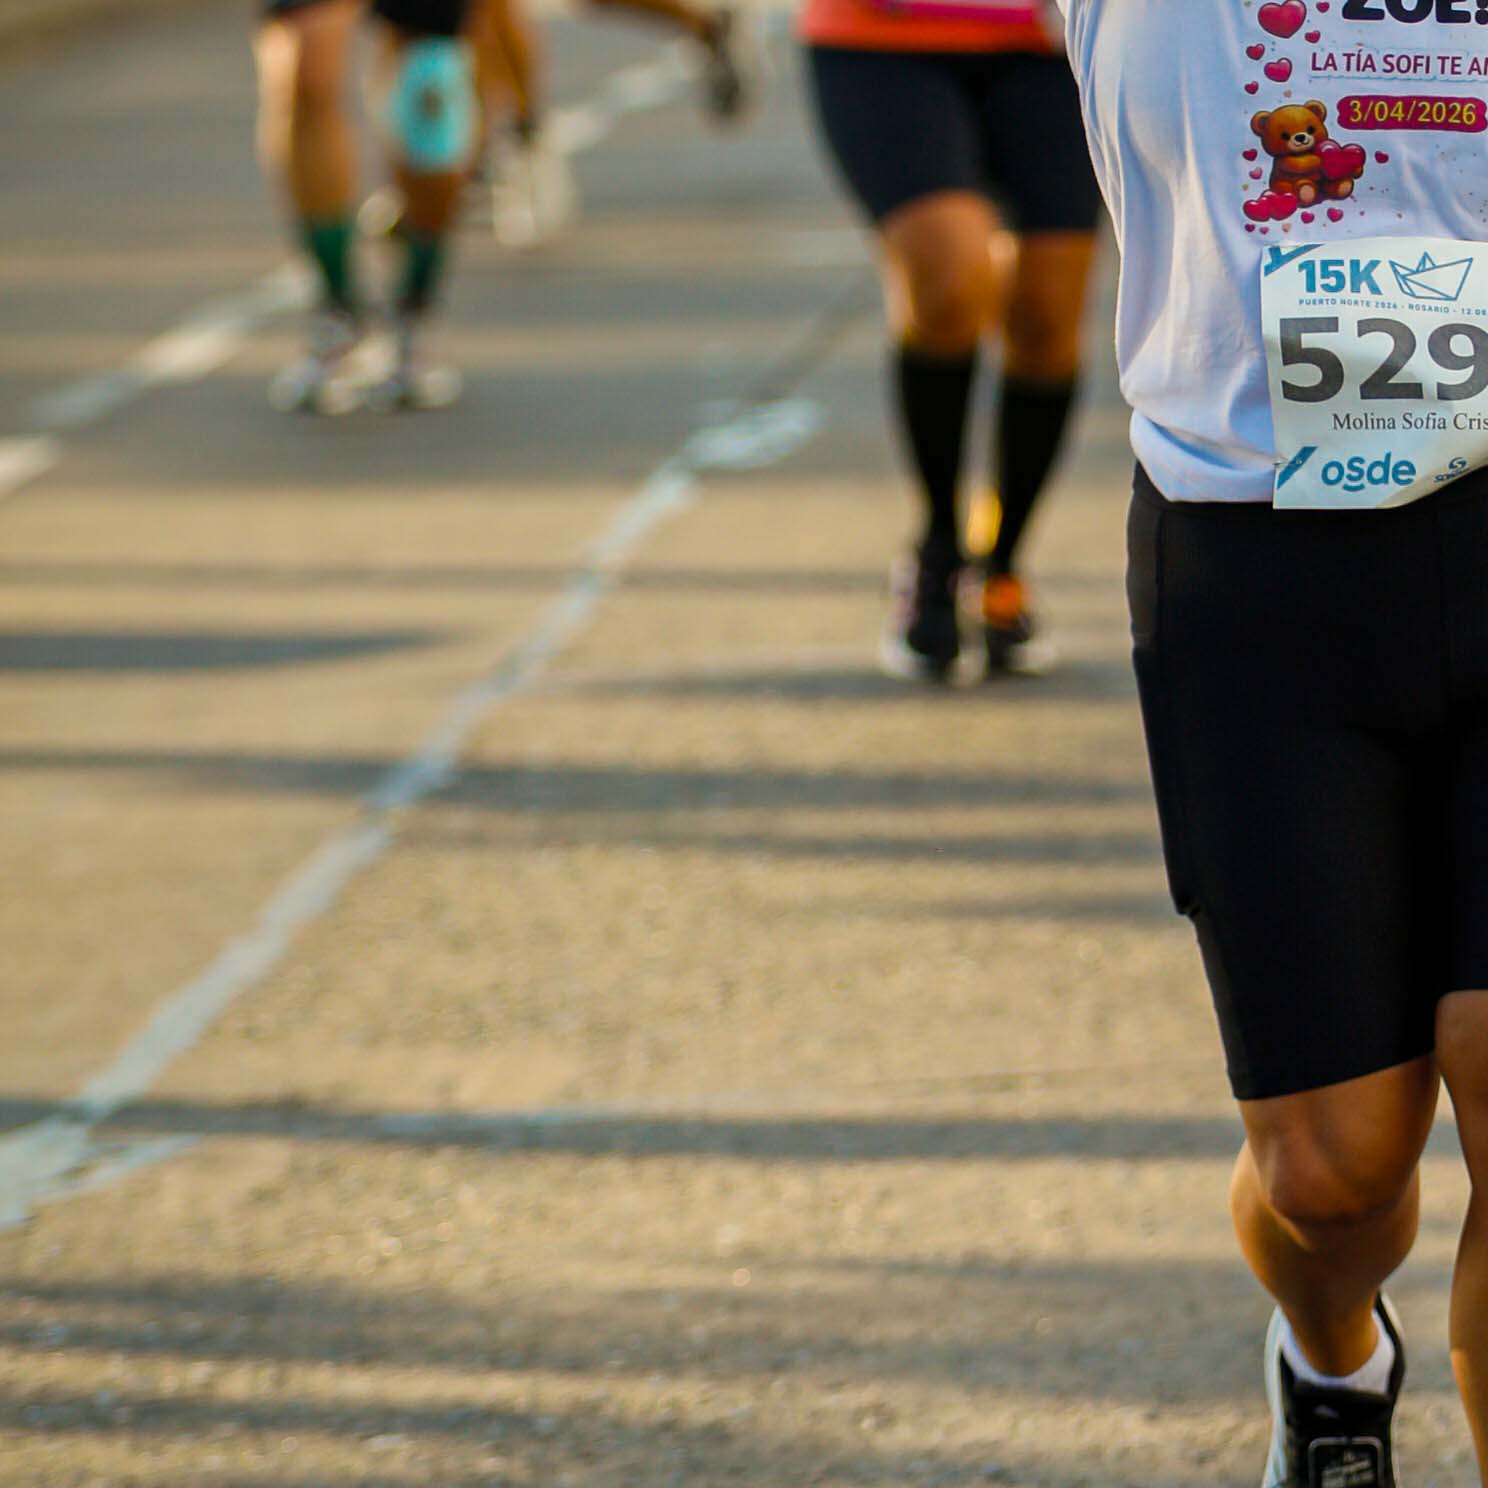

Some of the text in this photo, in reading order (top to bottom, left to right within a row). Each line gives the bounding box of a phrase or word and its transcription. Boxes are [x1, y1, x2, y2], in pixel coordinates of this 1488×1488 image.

[1311, 52, 1339, 72] LA
[1342, 49, 1377, 74] TÍA
[1382, 53, 1431, 75] SOFI
[1438, 55, 1462, 76] TE
[1348, 99, 1477, 126] 3/04/2026
[1297, 258, 1383, 296] 15K
[1298, 298, 1337, 306] PUERTO
[1340, 299, 1371, 308] NORTE
[1408, 303, 1450, 314] ROSARIO
[1332, 412, 1396, 431] Molina
[1320, 451, 1416, 492] osde
